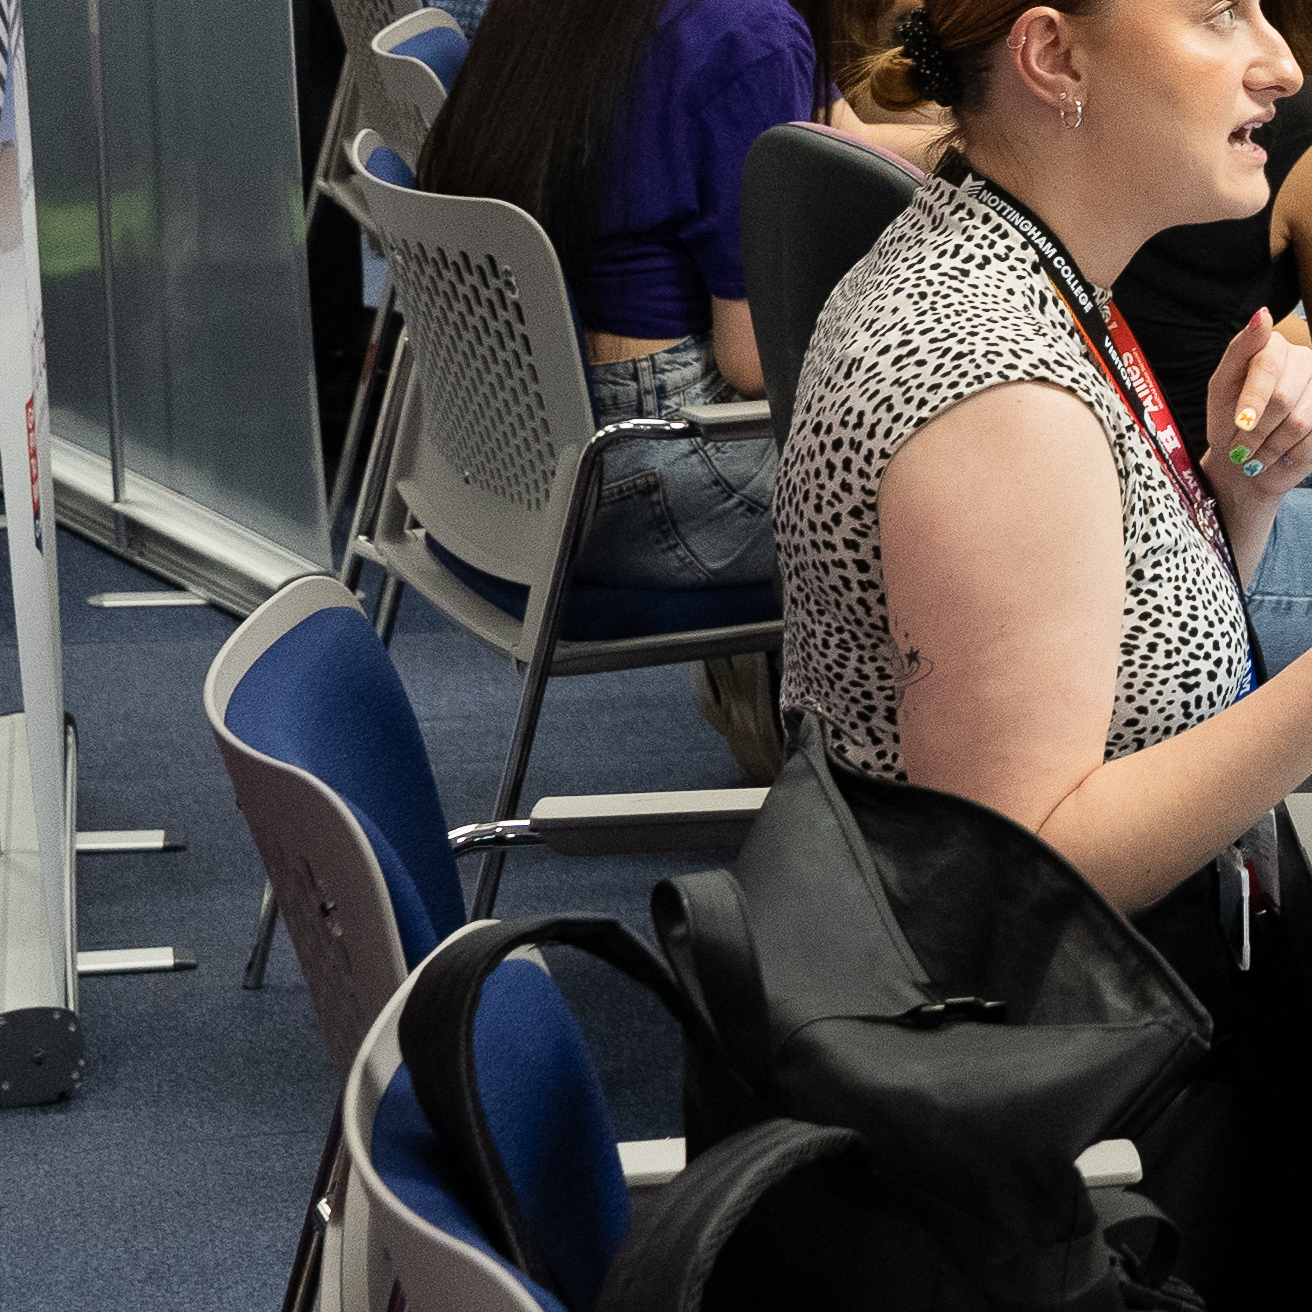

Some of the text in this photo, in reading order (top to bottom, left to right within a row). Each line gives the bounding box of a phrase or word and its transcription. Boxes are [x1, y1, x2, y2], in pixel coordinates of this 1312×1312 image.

[978, 190, 1094, 314] NOTTINGHAM COLLEGE
[1104, 335, 1132, 389] VISITOR
[1122, 351, 1159, 414] Allies
